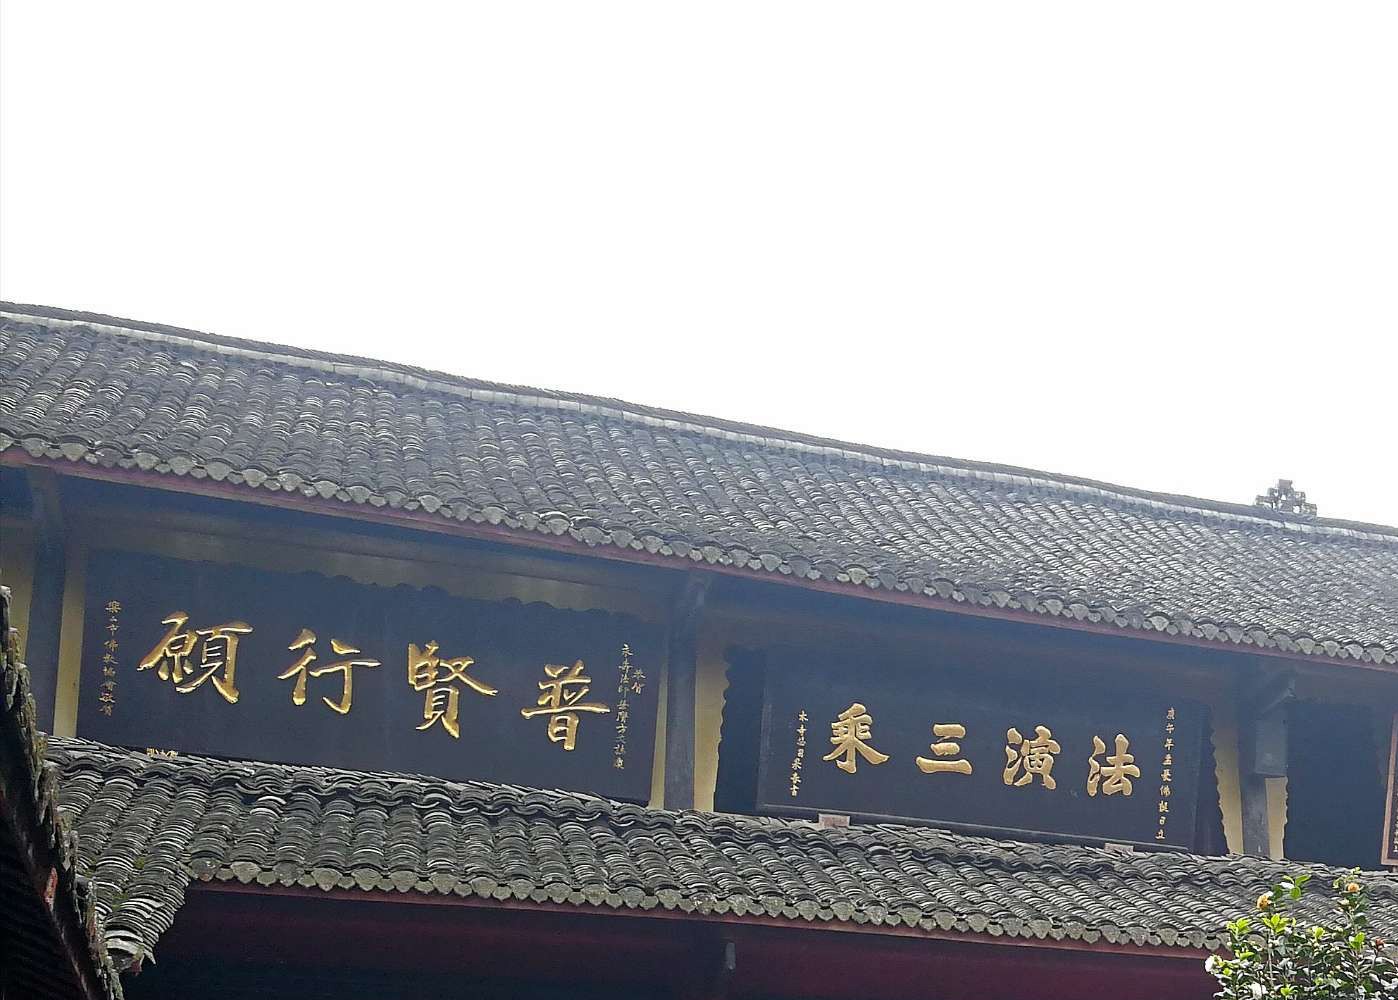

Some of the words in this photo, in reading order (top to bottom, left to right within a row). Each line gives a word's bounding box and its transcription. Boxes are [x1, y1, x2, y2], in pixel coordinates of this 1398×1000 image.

[137, 610, 611, 752] 普賢行願
[822, 701, 1142, 797] 法演三乘
